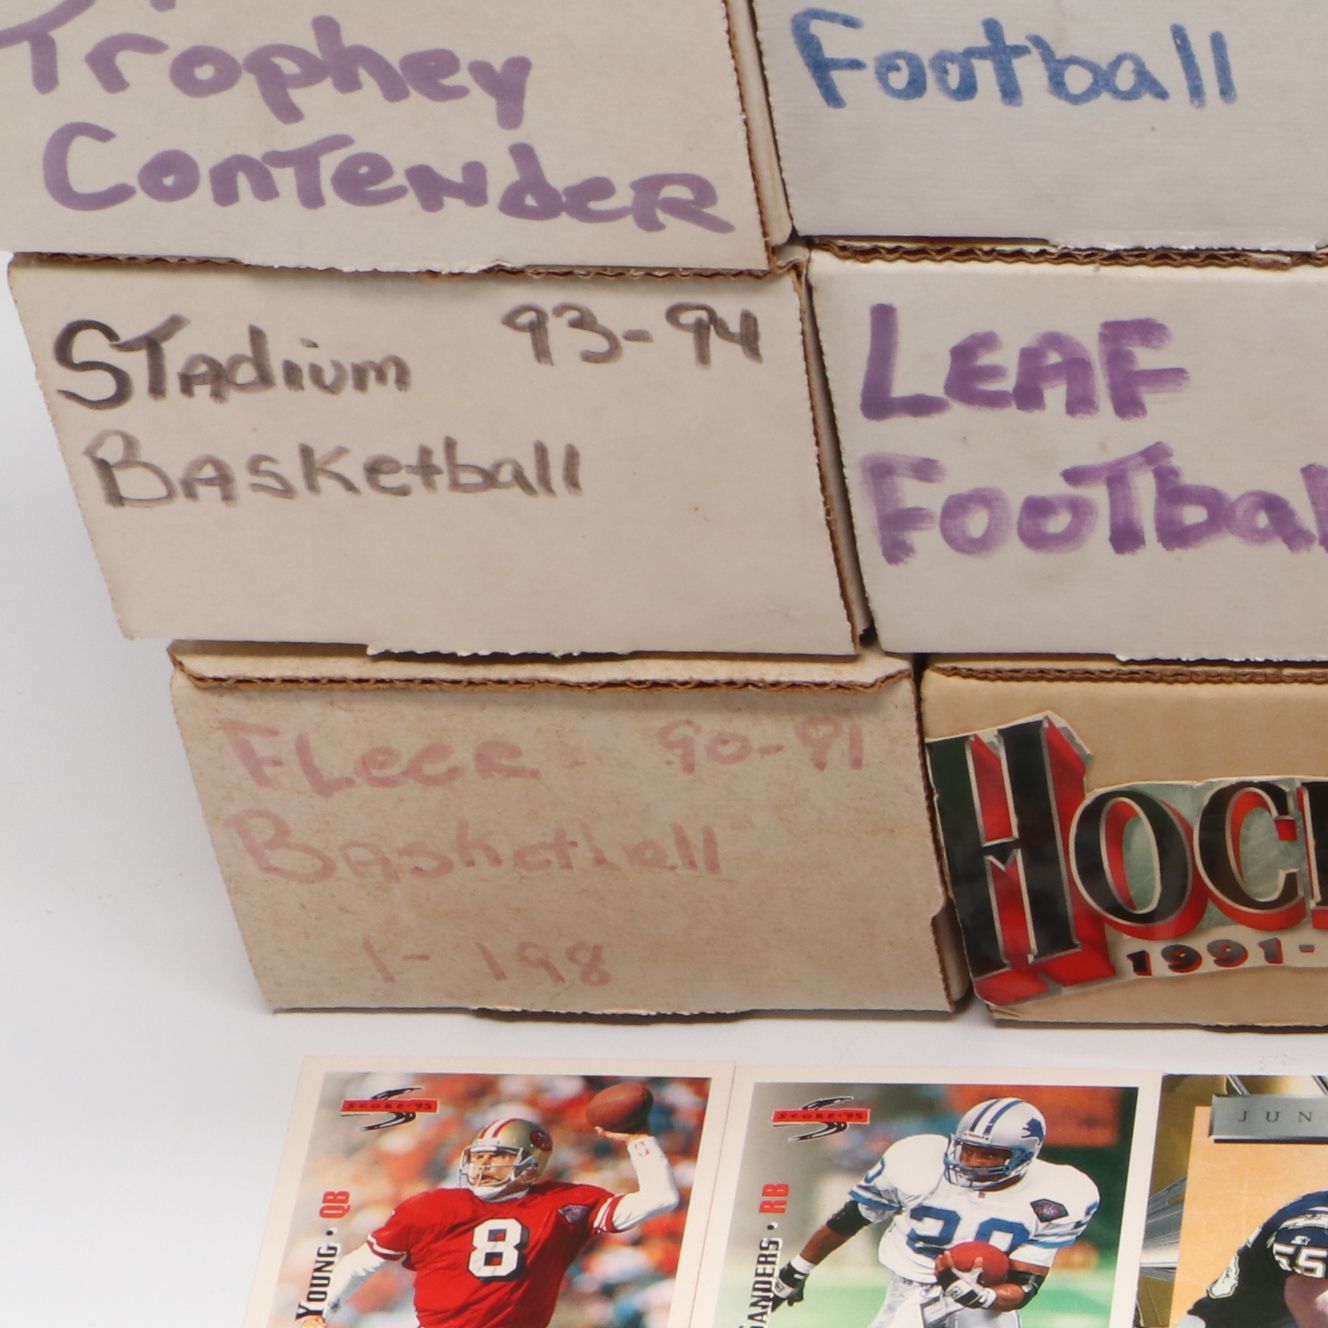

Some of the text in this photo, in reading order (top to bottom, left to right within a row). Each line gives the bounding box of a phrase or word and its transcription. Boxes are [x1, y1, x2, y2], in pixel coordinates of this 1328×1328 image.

[501, 302, 764, 368] 93-94
[860, 304, 1191, 421] LEAF
[758, 1183, 790, 1214] RB
[295, 1243, 339, 1321] YOUNG
[318, 1190, 352, 1219] QB
[467, 1217, 530, 1282] 8
